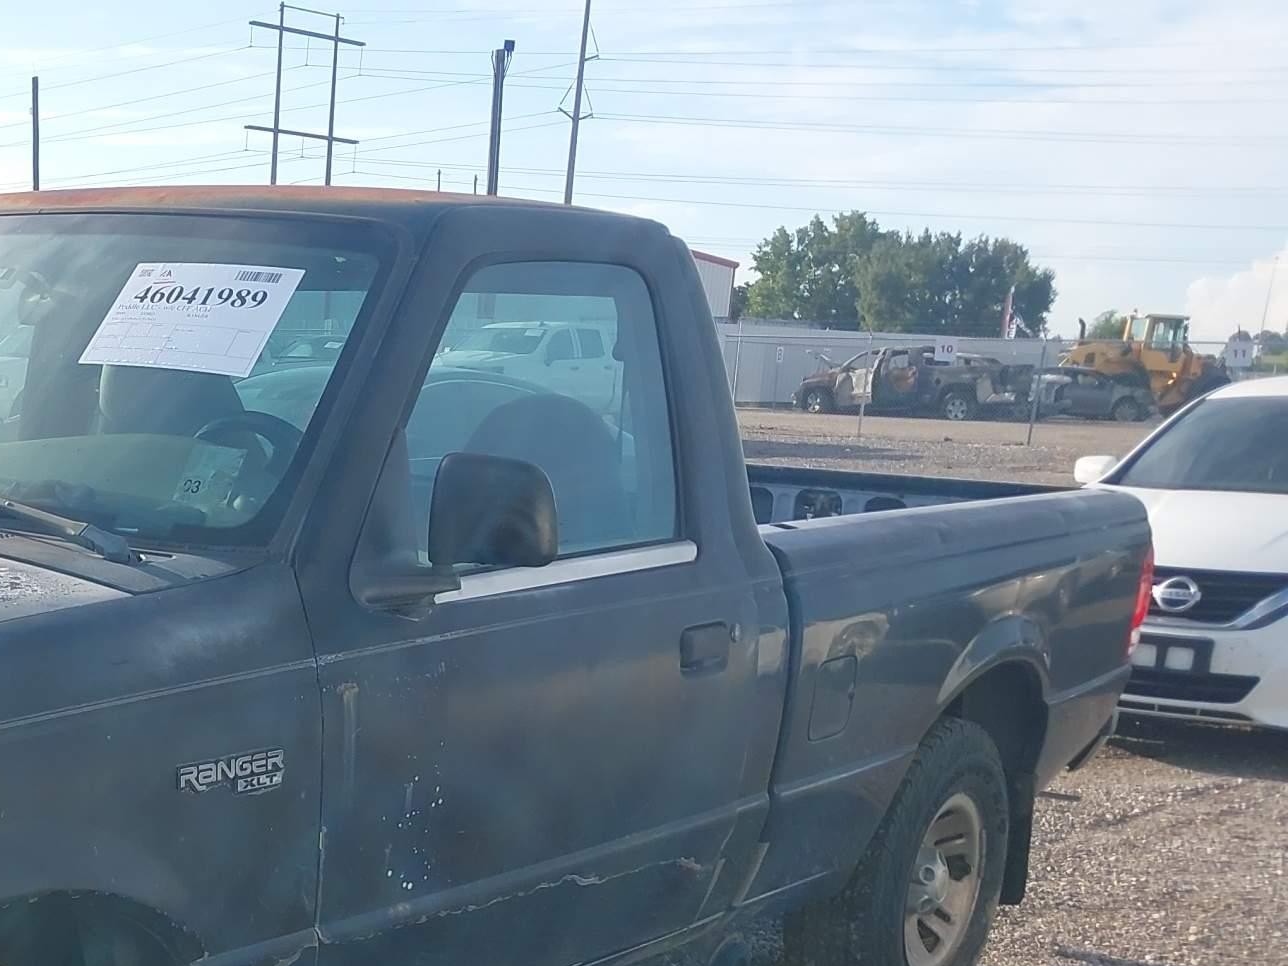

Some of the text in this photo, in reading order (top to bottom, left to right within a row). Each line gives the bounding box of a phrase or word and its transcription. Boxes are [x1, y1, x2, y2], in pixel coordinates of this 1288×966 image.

[133, 285, 268, 308] 46041989
[940, 345, 953, 353] 10
[240, 773, 279, 790] XLT
